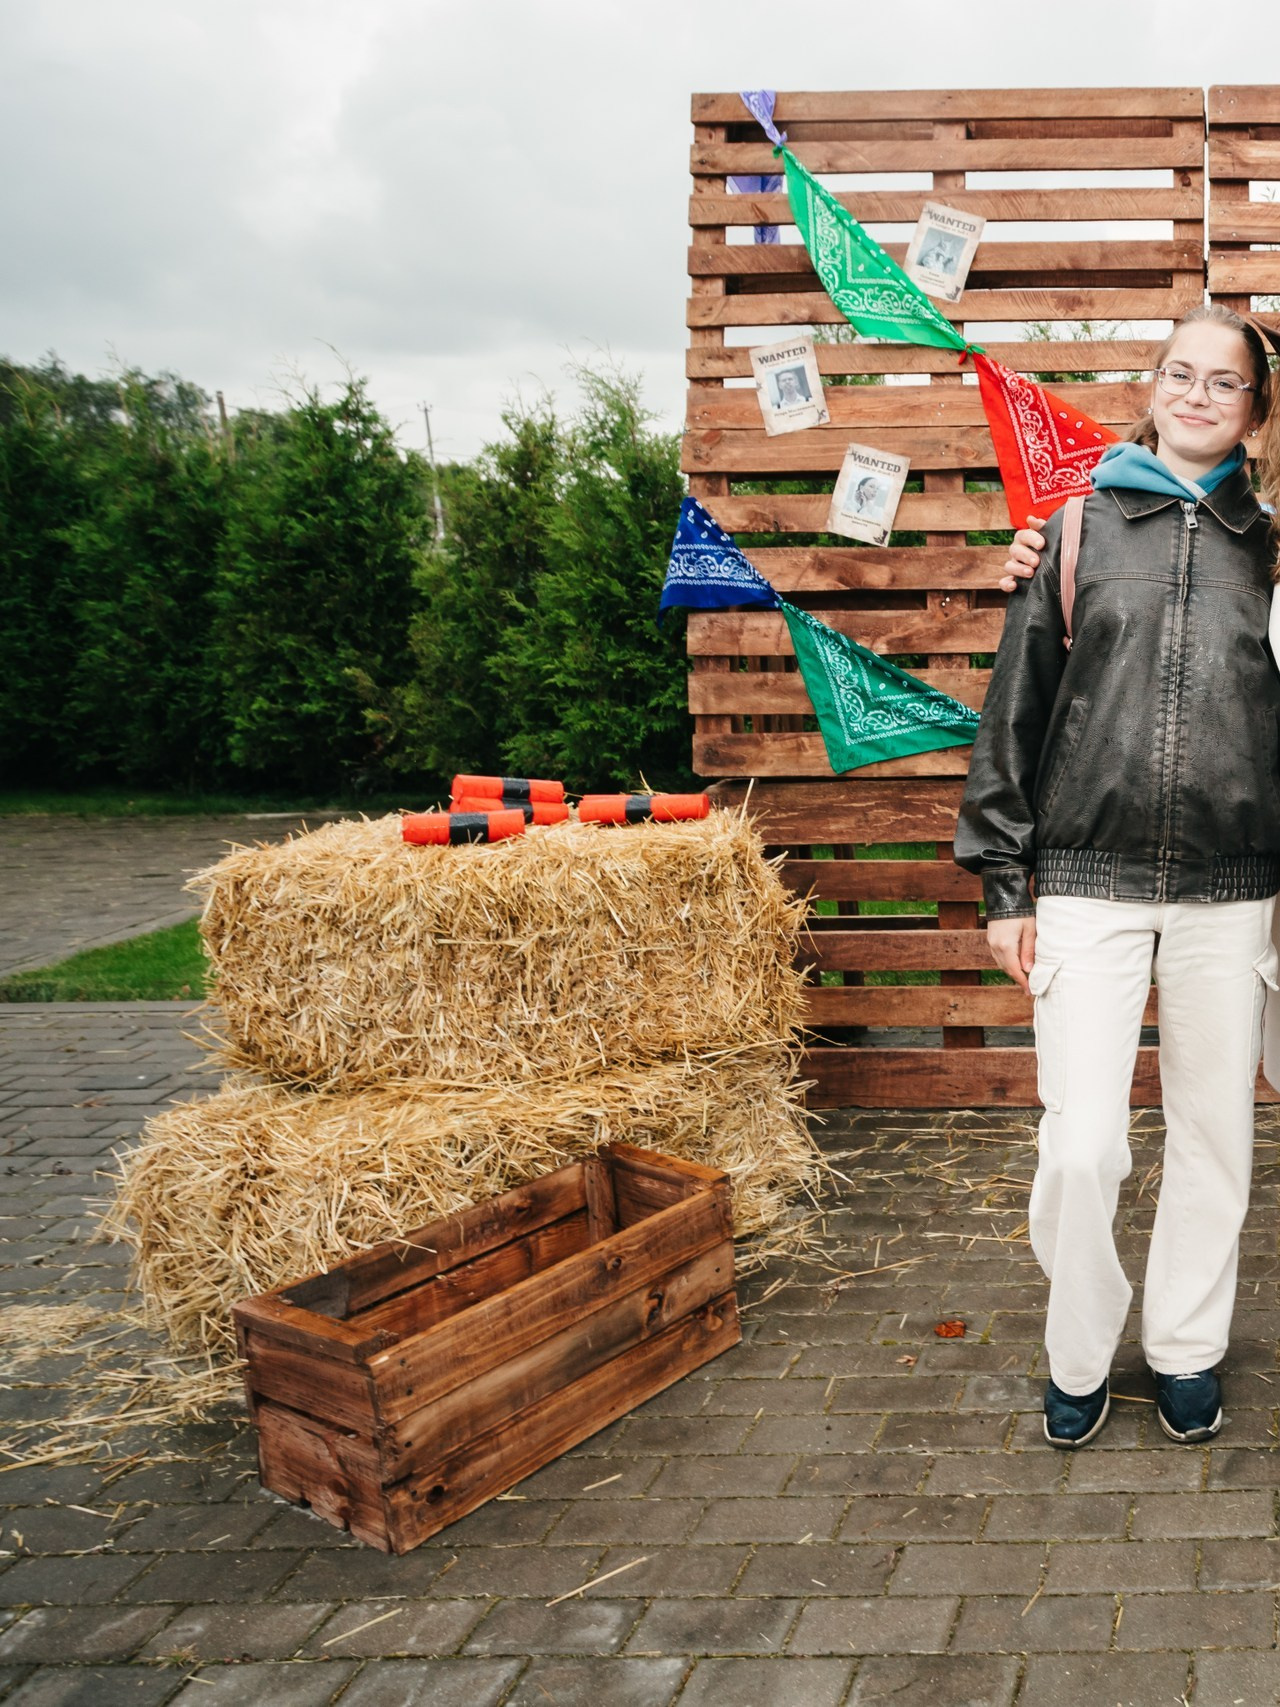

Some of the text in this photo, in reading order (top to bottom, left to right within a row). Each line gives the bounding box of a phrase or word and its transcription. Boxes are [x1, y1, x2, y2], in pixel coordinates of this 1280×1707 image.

[928, 212, 976, 232] WANTED
[757, 346, 807, 365] WANTED
[852, 454, 901, 473] WANTED
